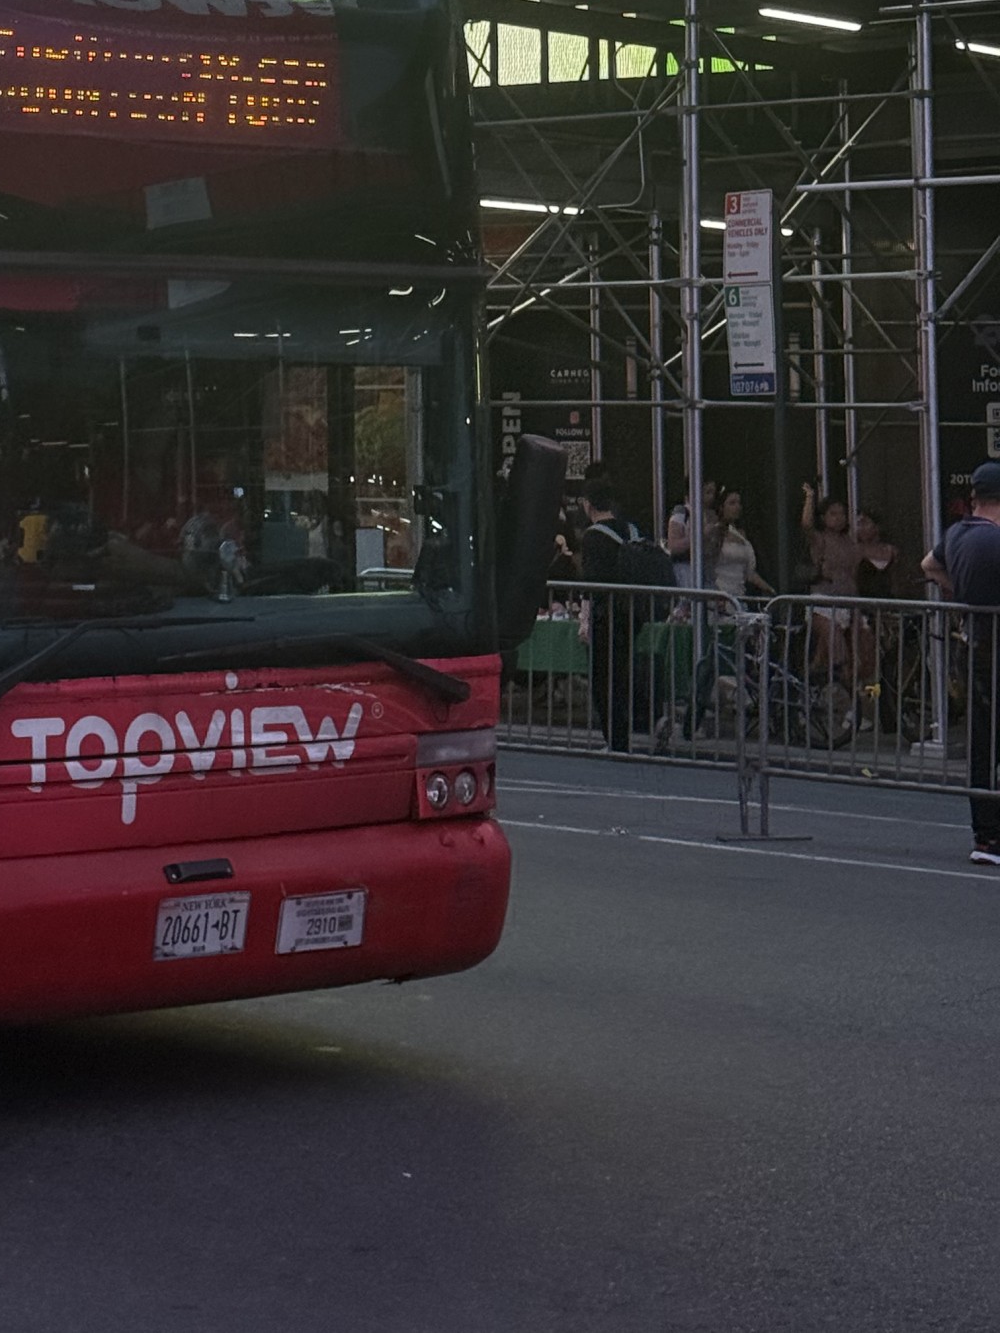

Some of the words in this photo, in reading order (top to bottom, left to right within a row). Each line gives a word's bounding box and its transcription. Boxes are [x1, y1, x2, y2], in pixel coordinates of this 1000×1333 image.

[729, 196, 739, 214] 3
[727, 228, 753, 238] VEHICLES
[728, 287, 738, 306] 6
[550, 369, 590, 378] CARNEG
[981, 365, 1000, 377] Fo
[972, 378, 1000, 392] Info
[181, 901, 202, 913] NEW
[204, 897, 227, 910] YORK
[306, 916, 338, 936] 2910
